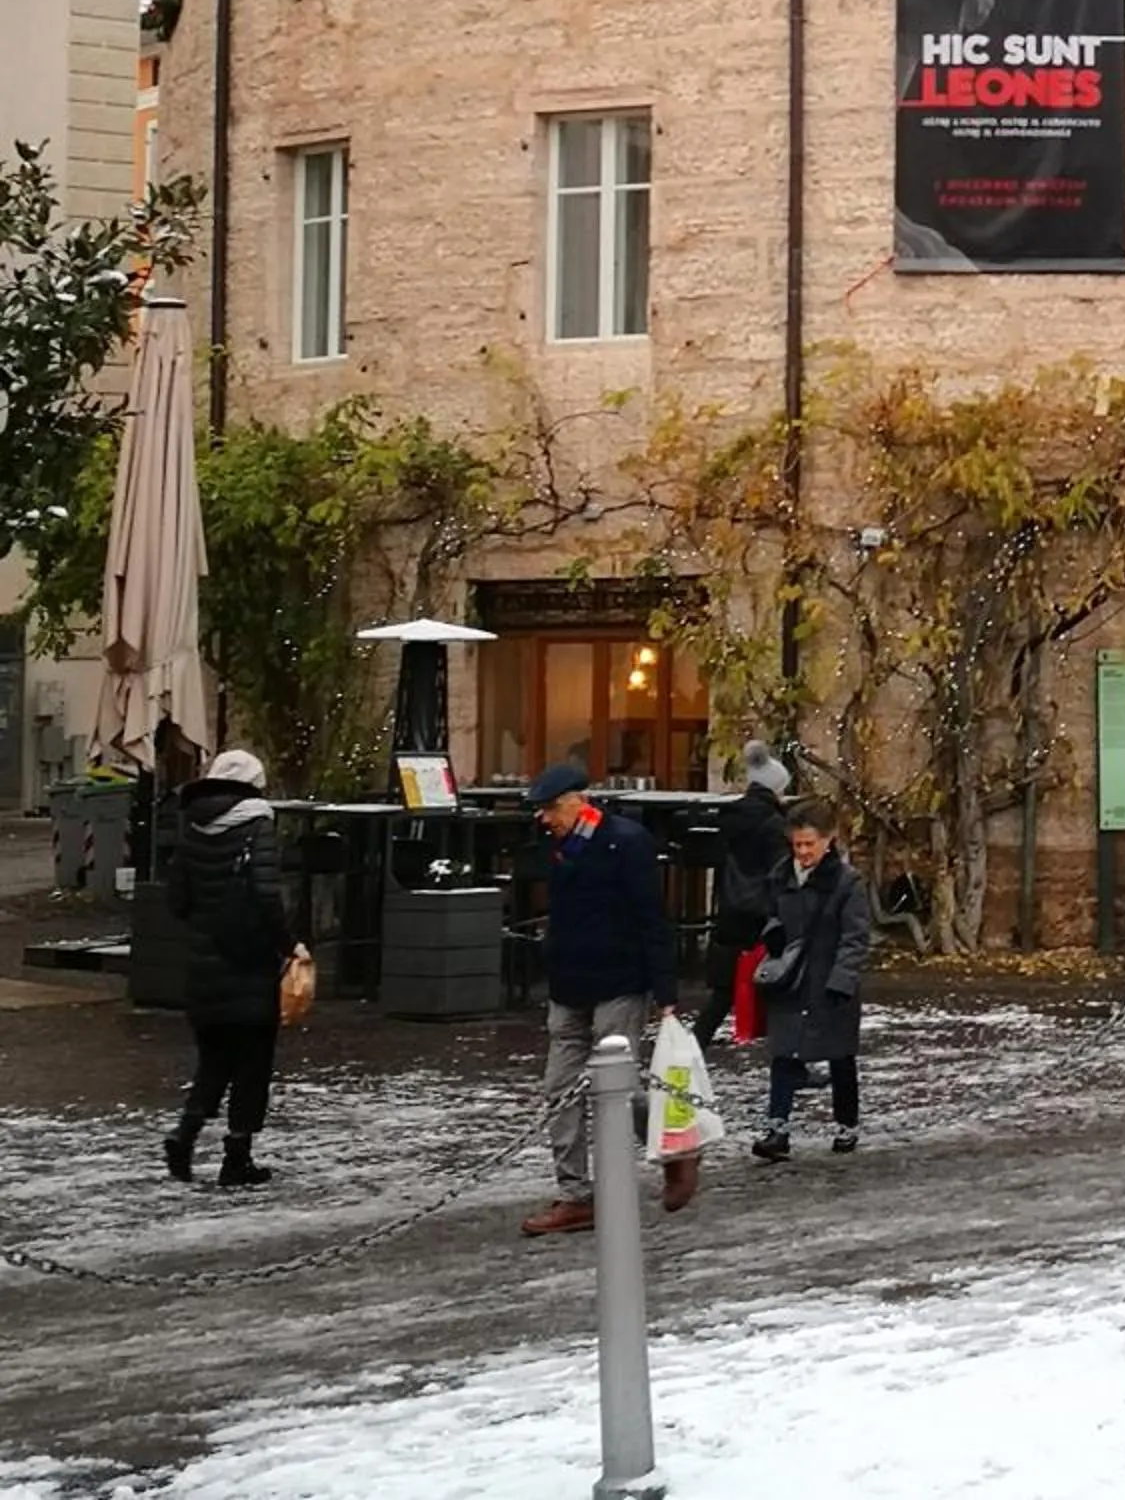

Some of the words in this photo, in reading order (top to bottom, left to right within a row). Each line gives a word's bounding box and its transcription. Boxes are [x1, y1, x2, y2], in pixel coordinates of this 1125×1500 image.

[922, 34, 990, 65] HIC
[1003, 35, 1102, 66] SUNT
[921, 67, 1102, 107] LEONES
